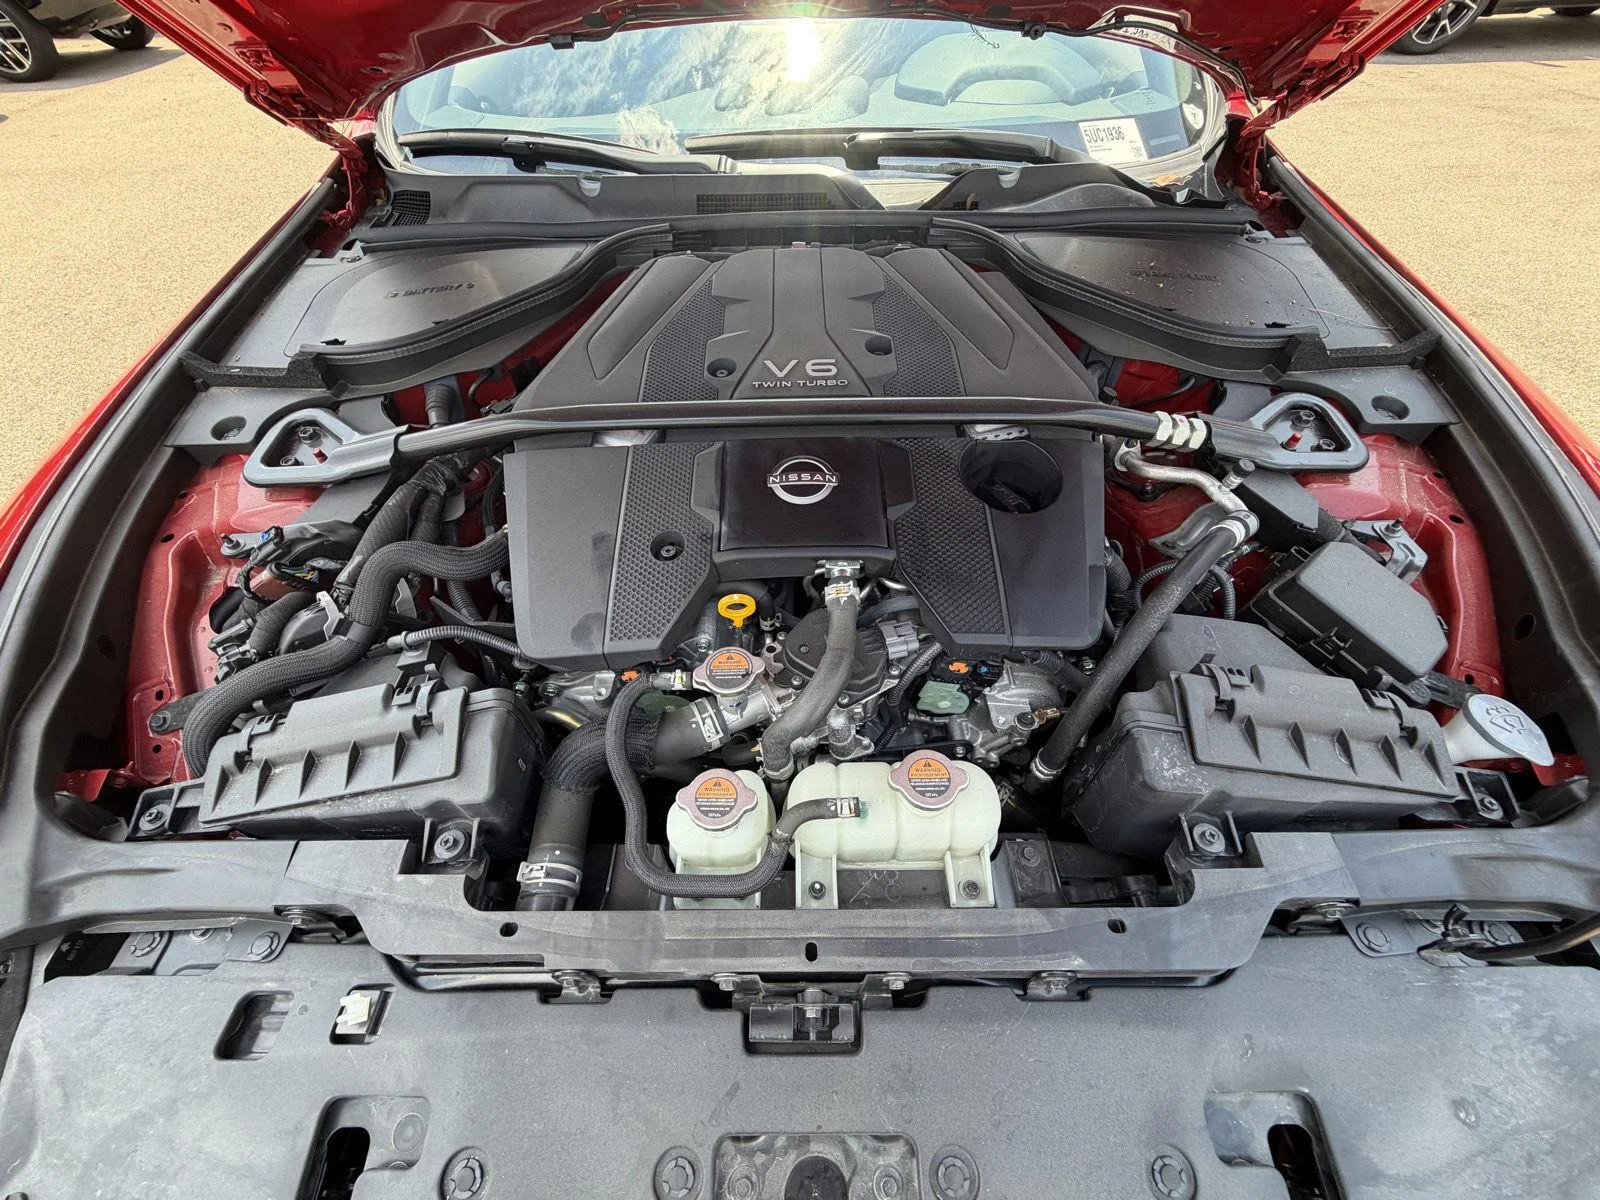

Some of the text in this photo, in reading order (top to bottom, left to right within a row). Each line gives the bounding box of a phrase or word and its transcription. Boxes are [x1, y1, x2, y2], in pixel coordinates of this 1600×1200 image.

[1083, 126, 1125, 144] 5UC1936
[763, 358, 838, 378] V6
[797, 379, 848, 387] TURBO
[769, 473, 836, 484] NISSAN
